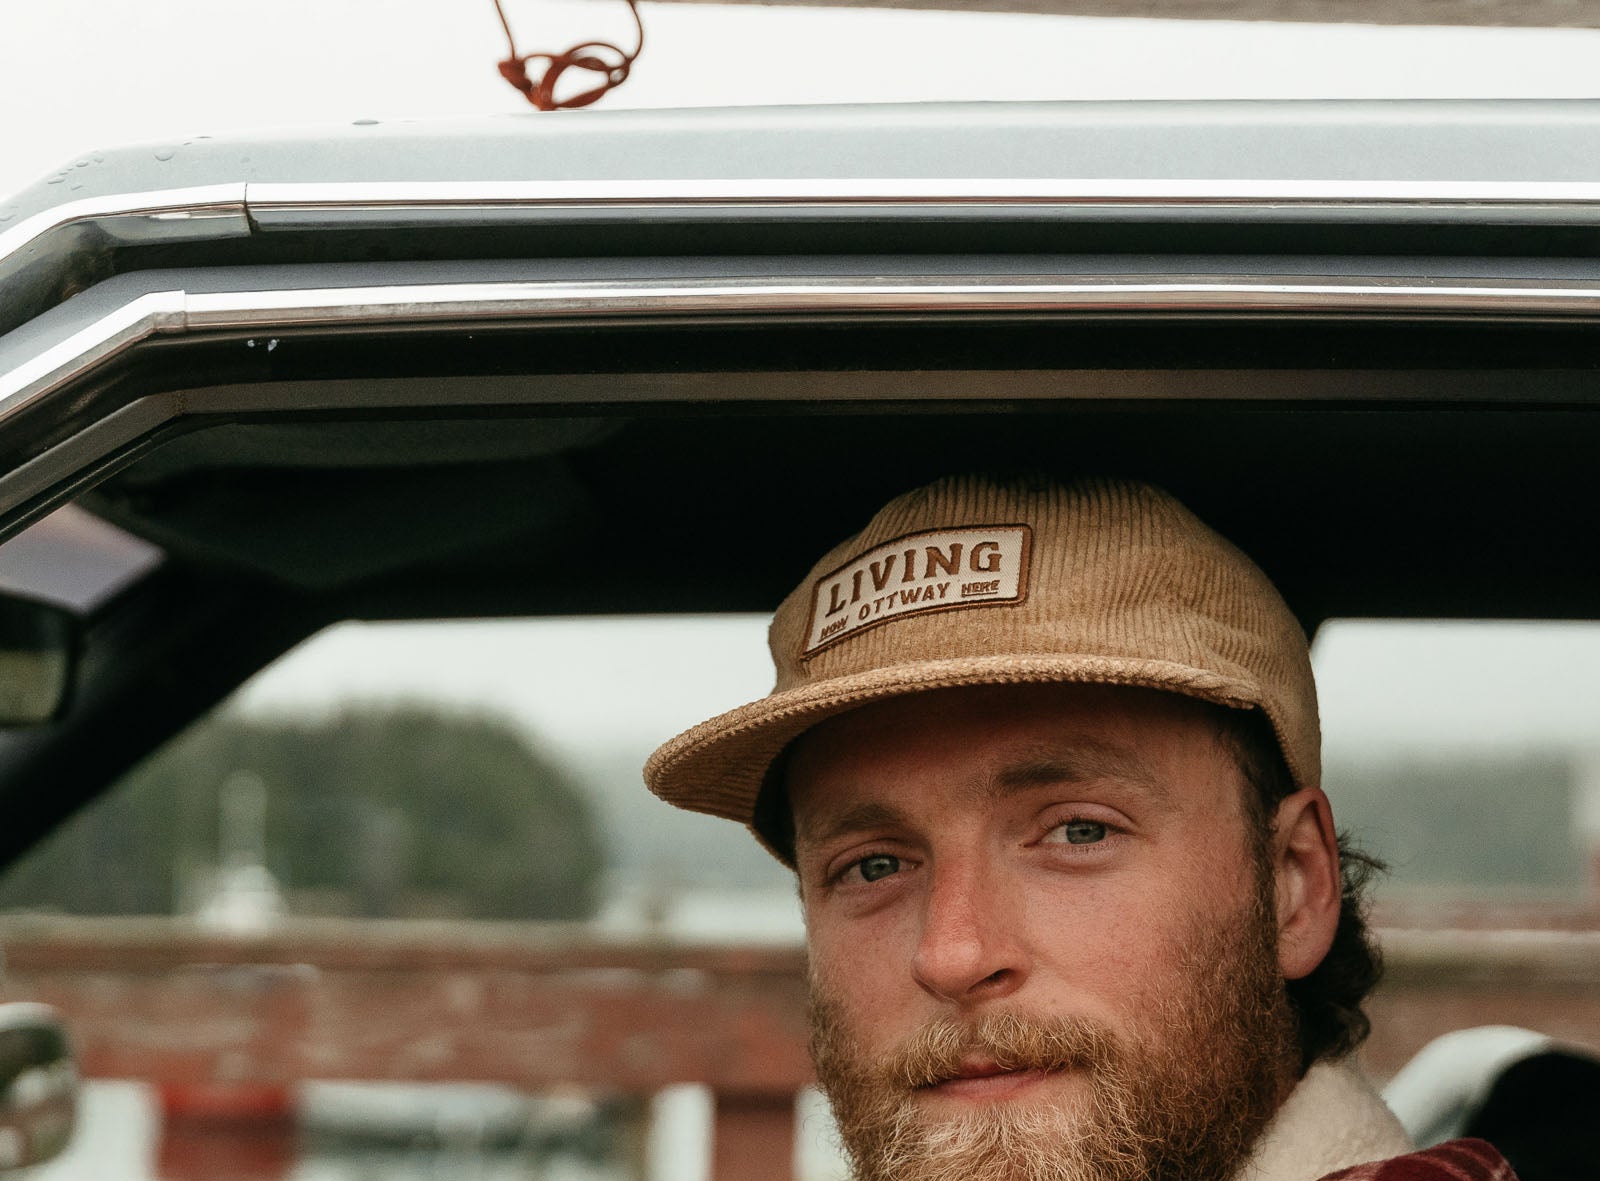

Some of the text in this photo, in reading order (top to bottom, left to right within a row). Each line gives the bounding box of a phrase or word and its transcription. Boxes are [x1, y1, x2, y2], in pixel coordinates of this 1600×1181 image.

[820, 580, 1000, 639] NOW OTTWAY HERE
[825, 541, 1002, 618] LIVING
